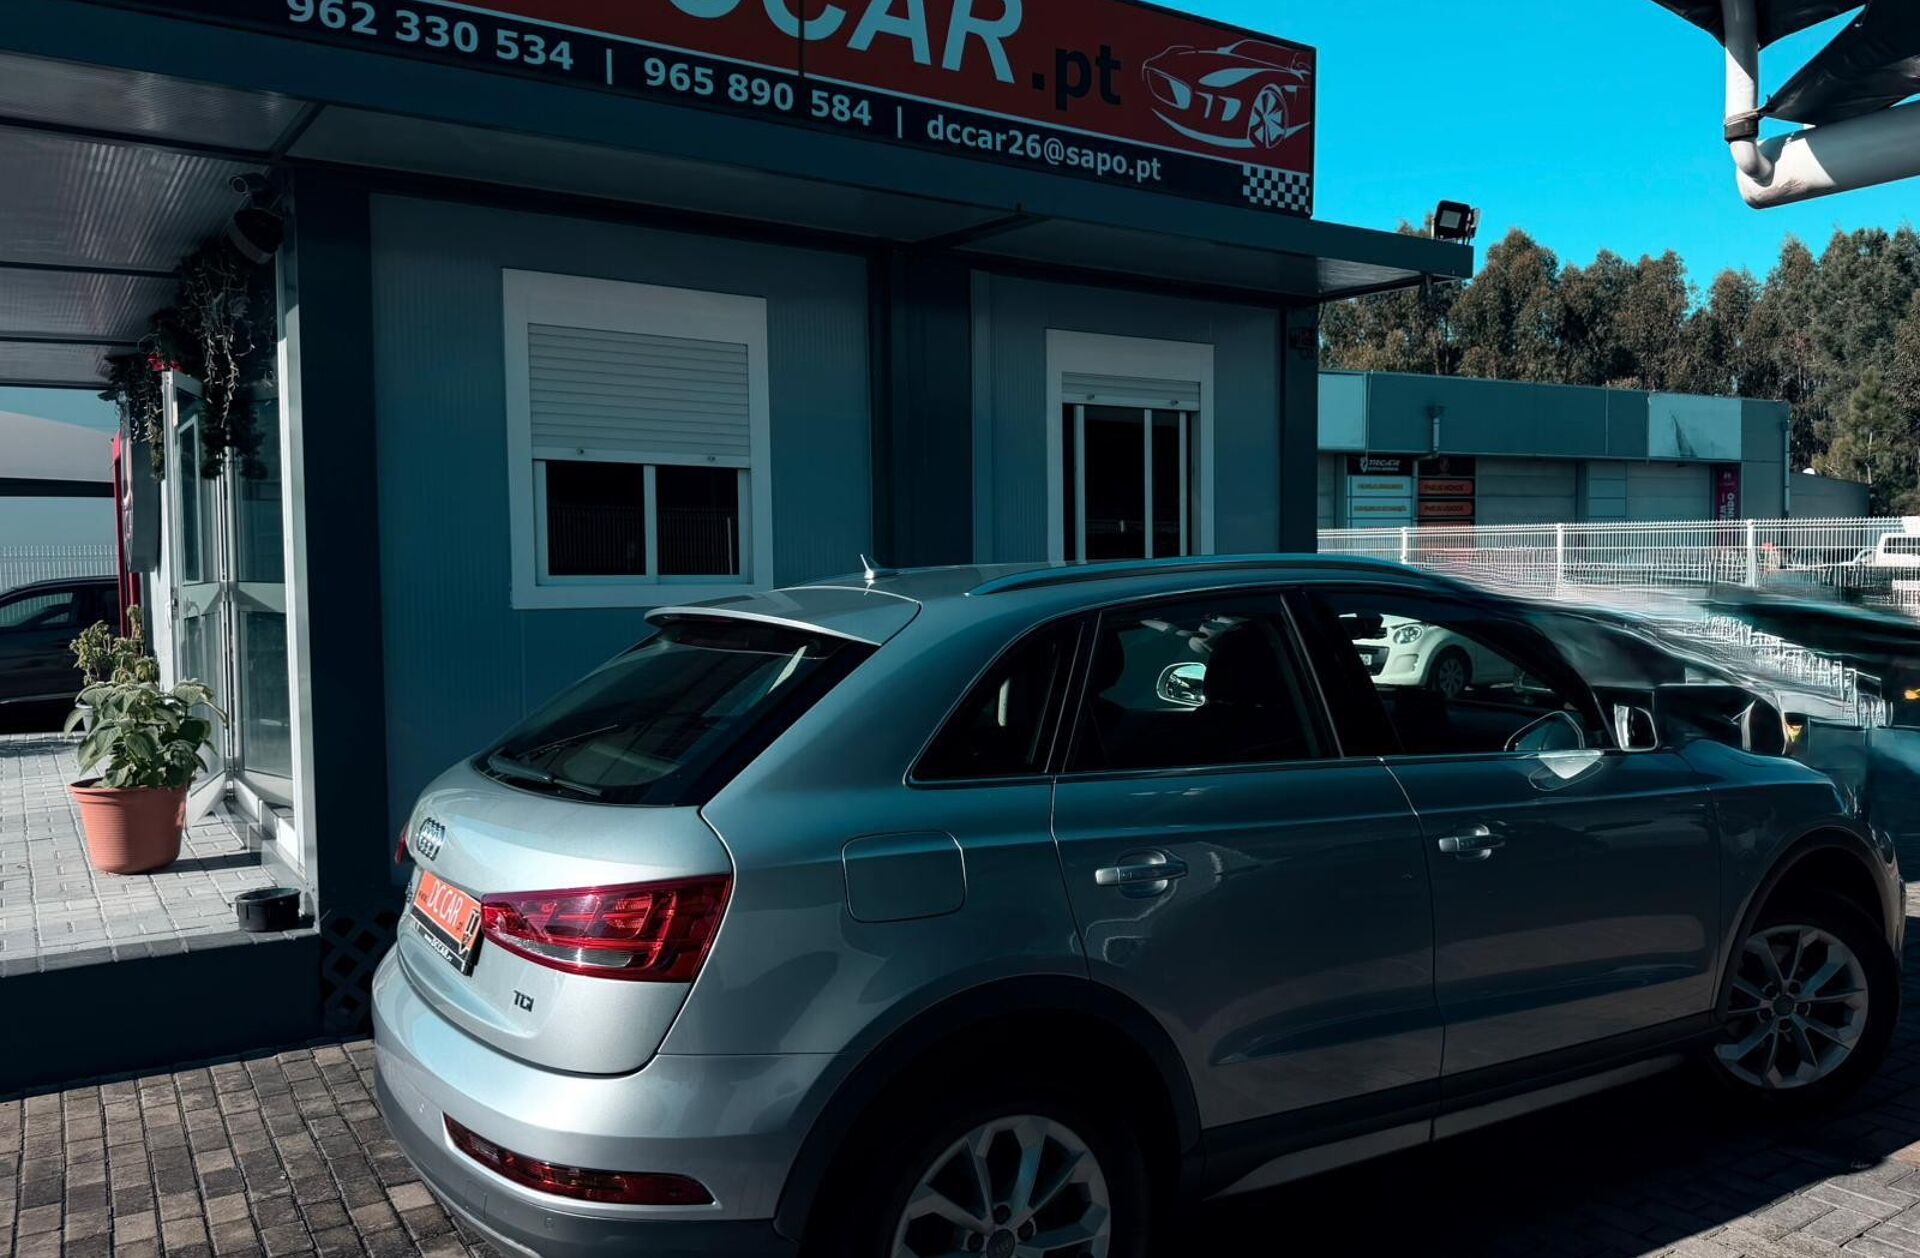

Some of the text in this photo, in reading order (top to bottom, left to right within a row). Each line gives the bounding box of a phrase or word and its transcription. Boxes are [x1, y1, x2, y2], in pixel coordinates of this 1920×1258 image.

[286, 0, 1161, 183] 962 330 534 965 890 584 dccar26@sapo.pt
[668, 0, 1121, 111] AR.pt
[513, 989, 535, 1013] TDI
